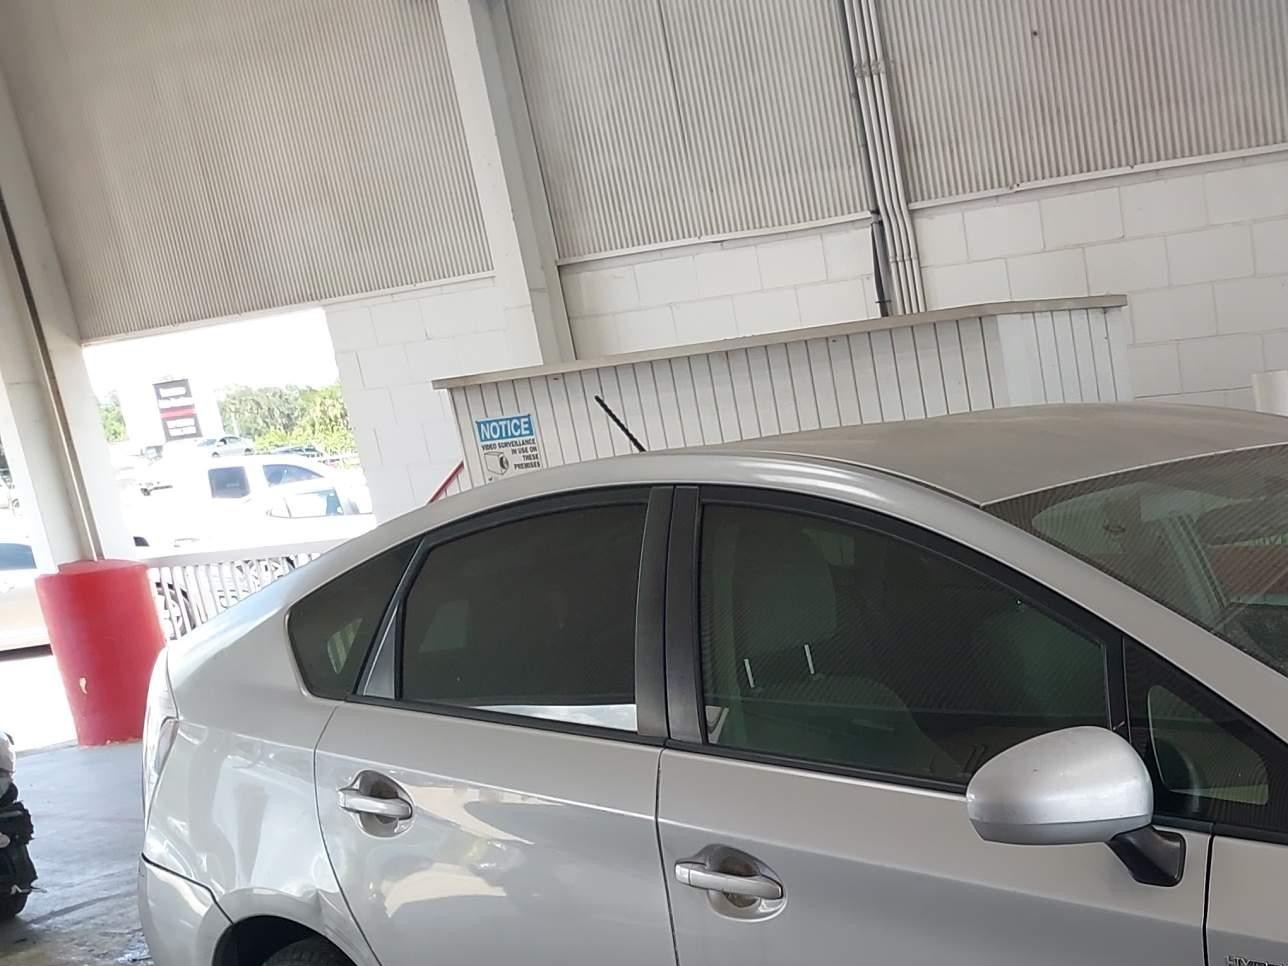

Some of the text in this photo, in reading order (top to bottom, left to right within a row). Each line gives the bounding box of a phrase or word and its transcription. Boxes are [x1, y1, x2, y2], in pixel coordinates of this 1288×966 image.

[480, 418, 530, 440] NOTICE
[481, 438, 536, 451] VIDEO SURVEILLANCE
[522, 453, 539, 461] THESE
[513, 461, 541, 470] PREMISES
